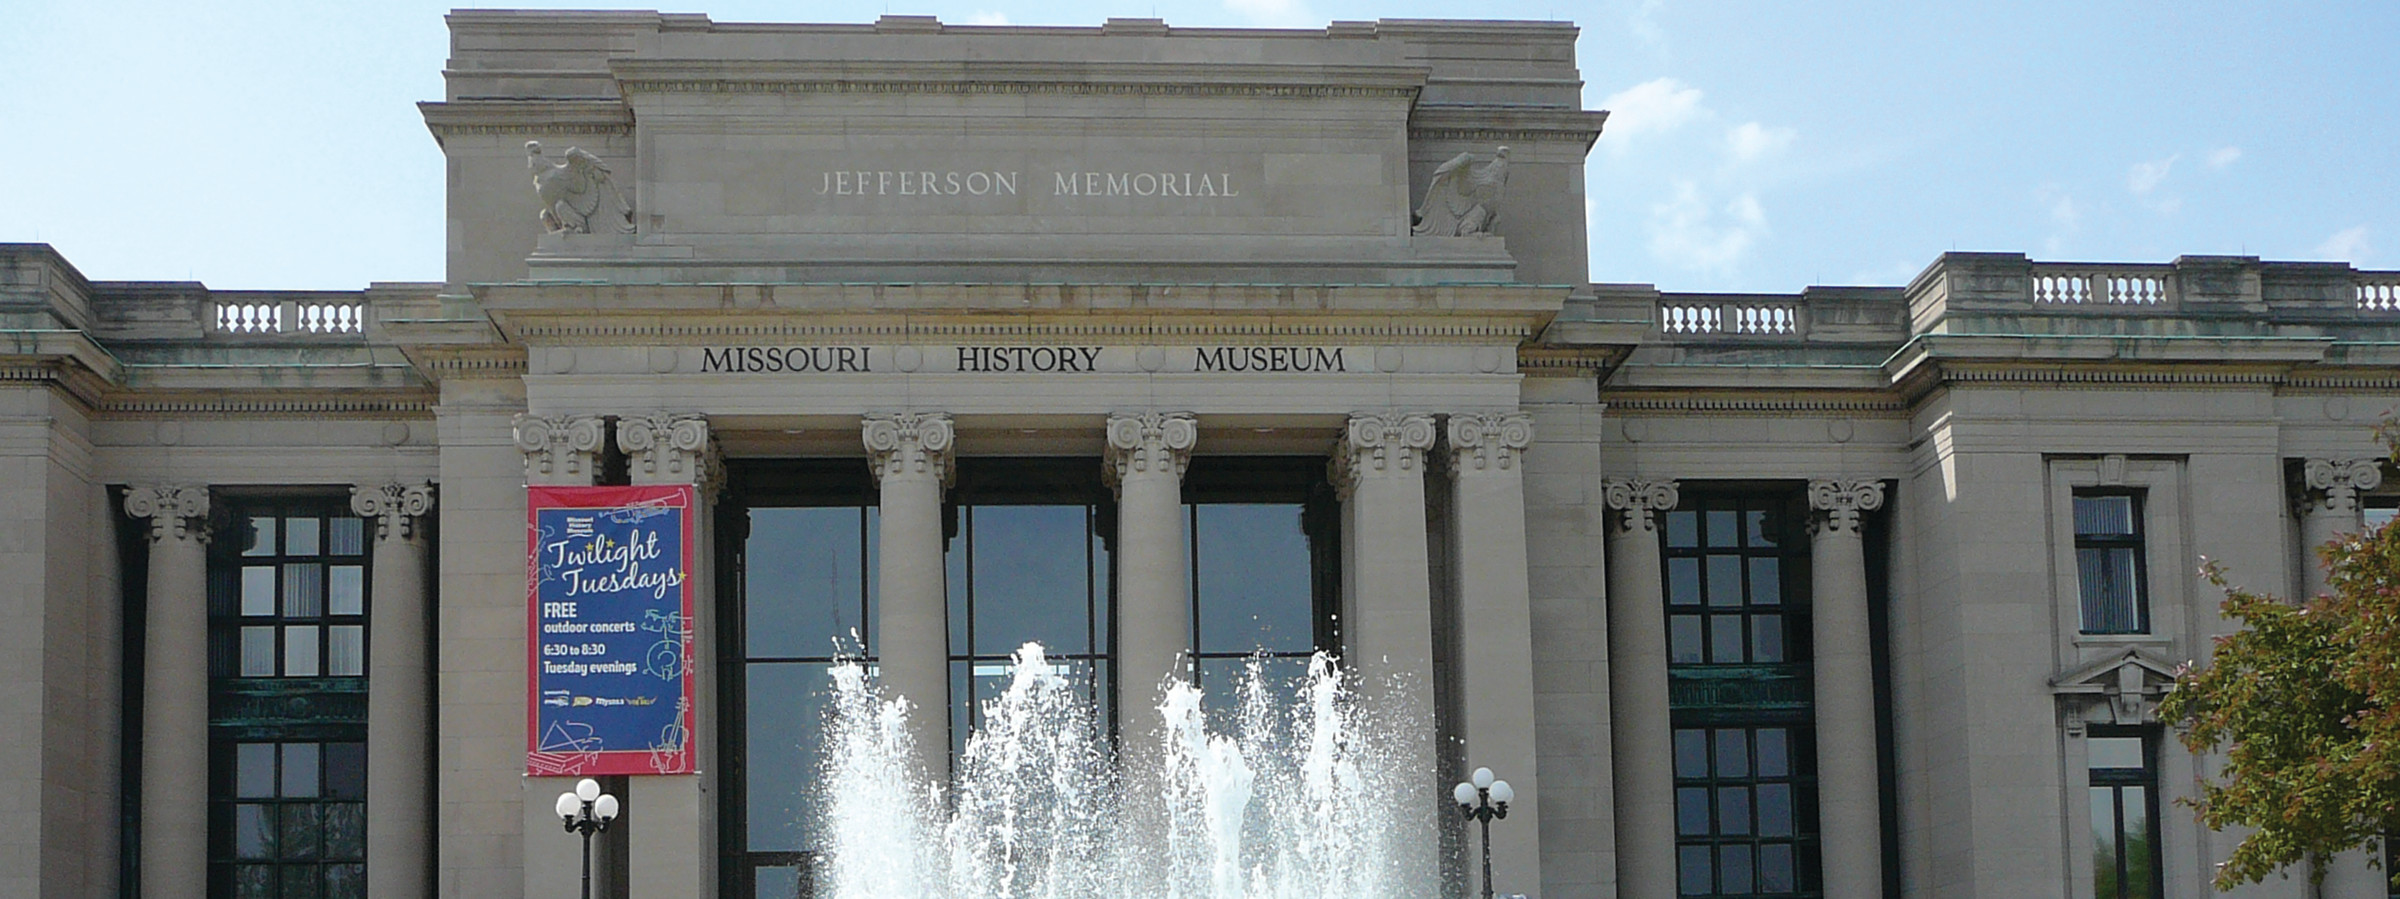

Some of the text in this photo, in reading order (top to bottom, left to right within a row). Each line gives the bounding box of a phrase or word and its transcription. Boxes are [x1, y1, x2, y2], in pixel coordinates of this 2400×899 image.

[814, 171, 1240, 198] JEFFERSON MEMORIAL
[700, 346, 1347, 373] MISSOURI HISTORY MUSEUM
[547, 528, 661, 574] Twilight
[561, 561, 682, 600] Tuesdays
[544, 602, 577, 618] FREE
[544, 621, 636, 633] outdoor concerts
[543, 643, 606, 655] 6:30 to 8:30
[543, 660, 638, 676] Tuesday evenings
